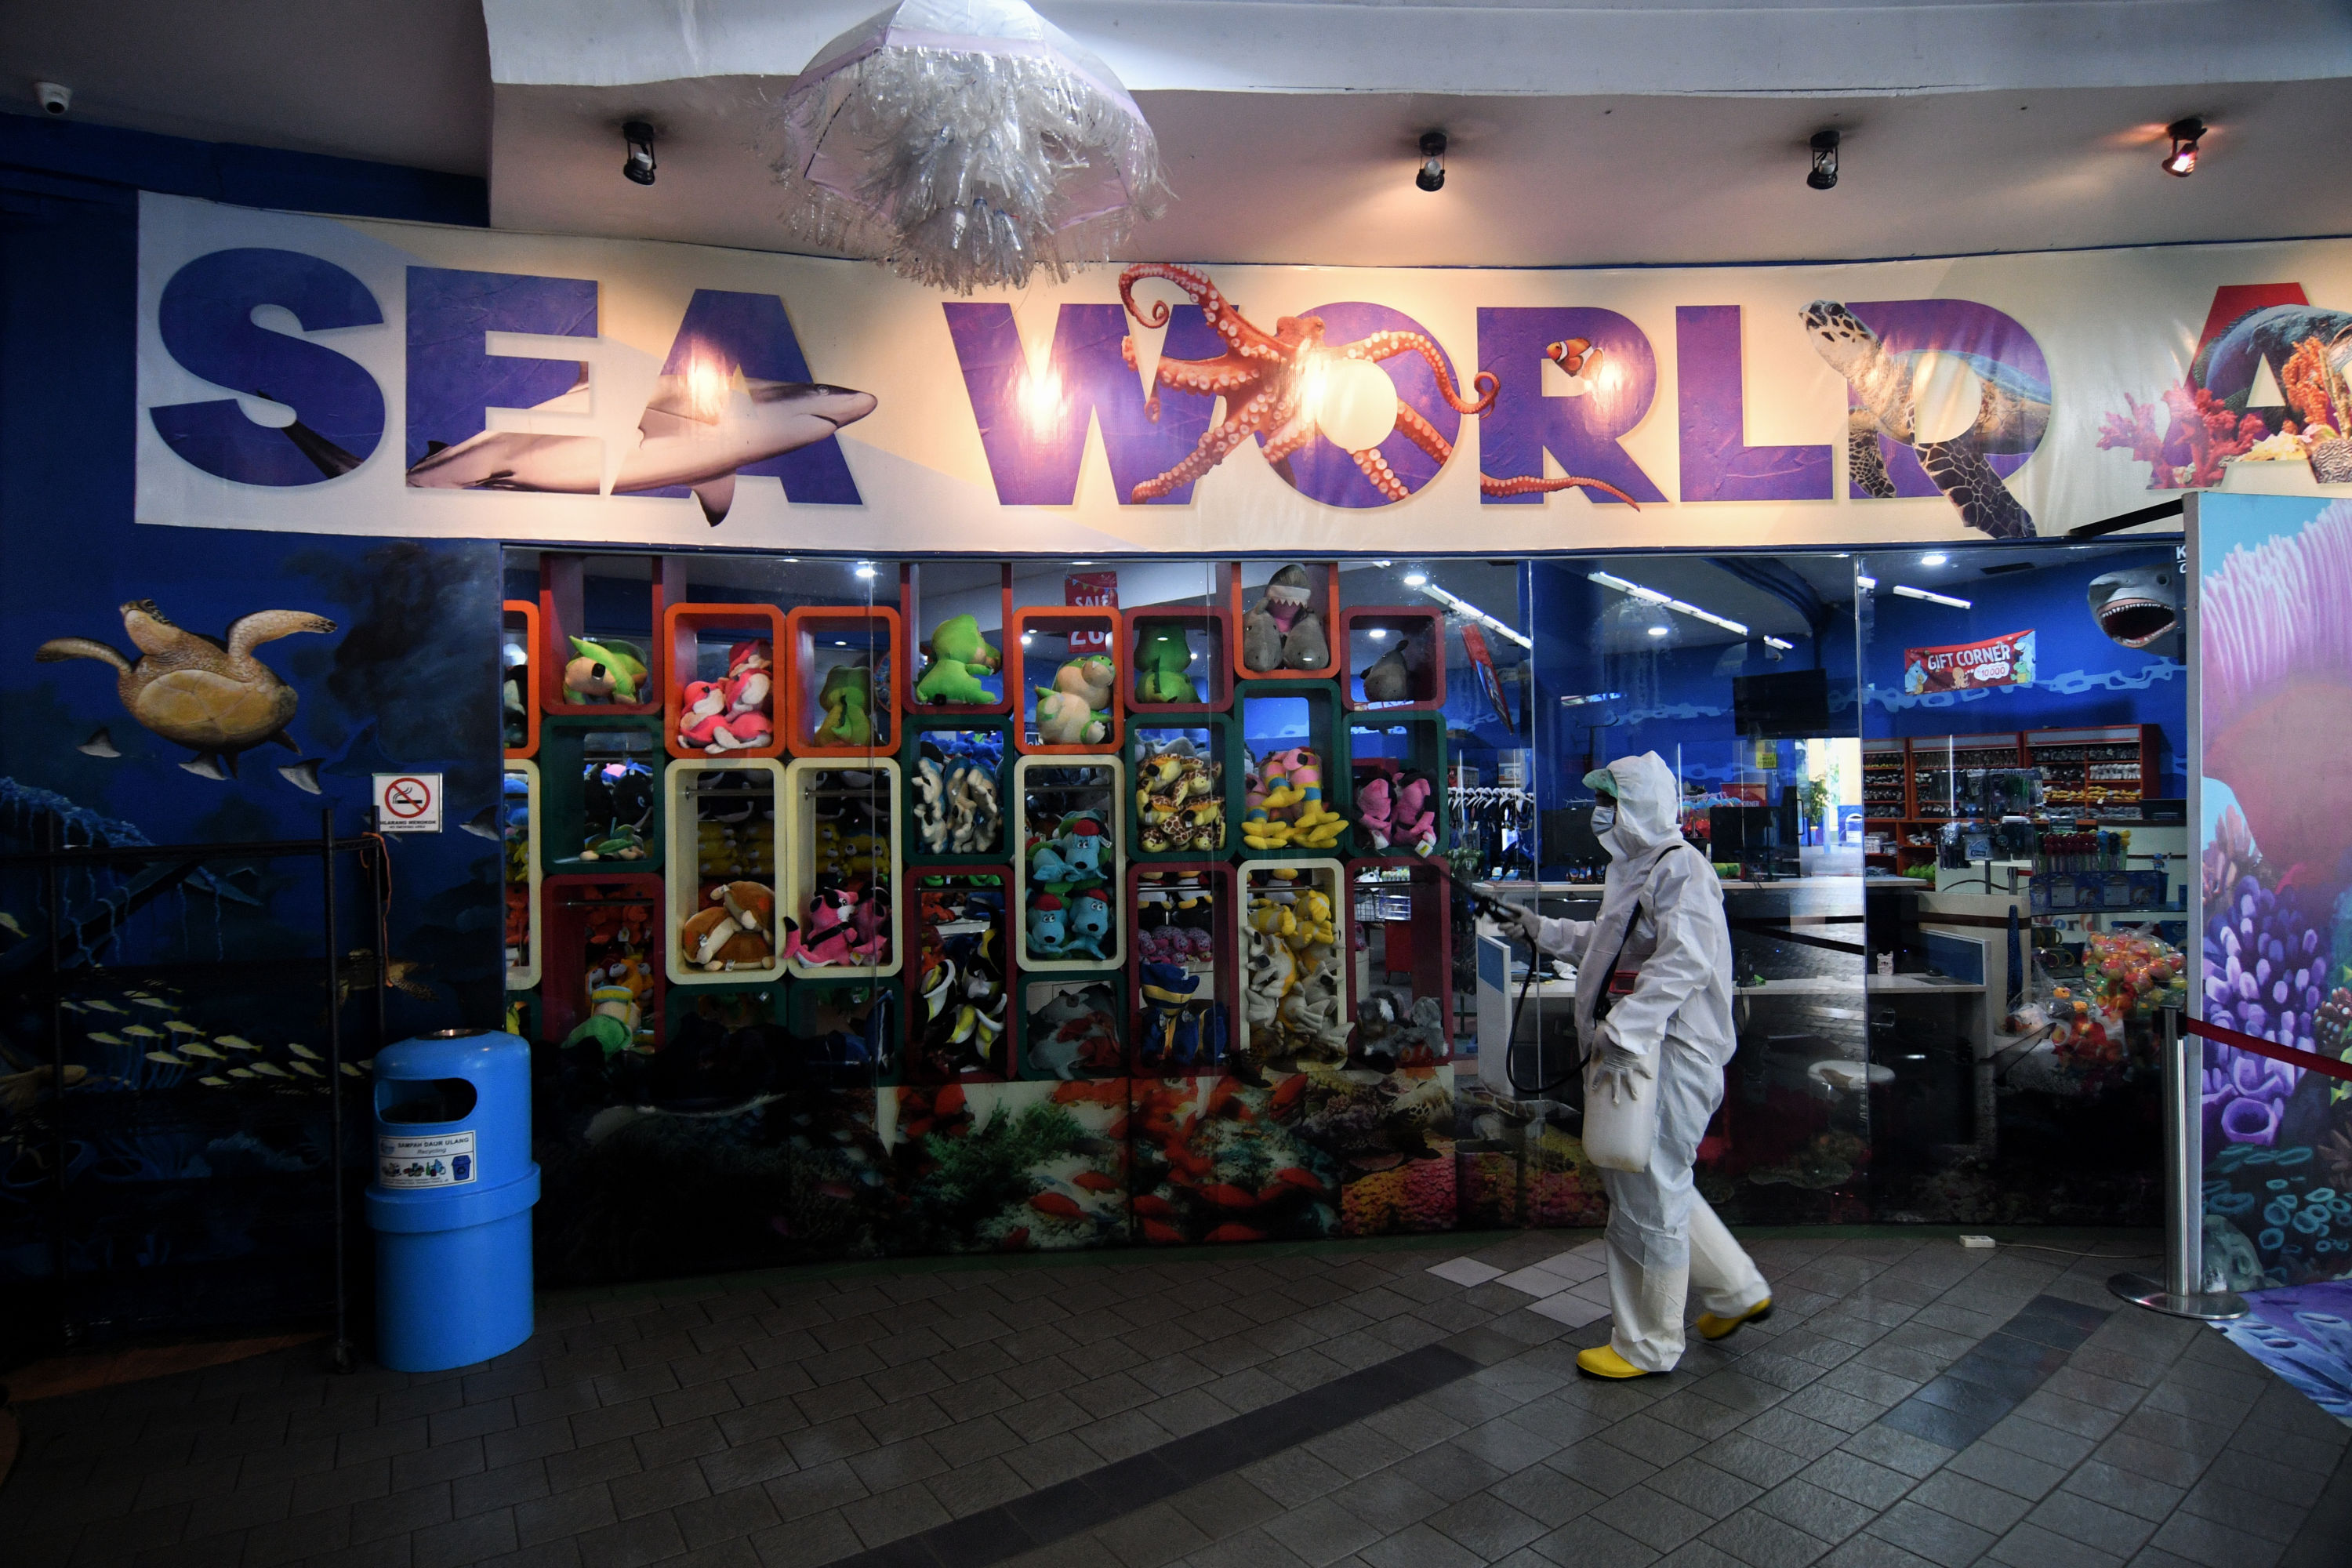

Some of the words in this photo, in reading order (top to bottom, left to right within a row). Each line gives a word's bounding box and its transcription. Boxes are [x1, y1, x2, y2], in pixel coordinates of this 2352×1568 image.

[151, 247, 862, 506] SEA
[942, 299, 2052, 509] WORLD
[1927, 652, 1953, 670] GIFT
[1956, 644, 2011, 667] CORNER
